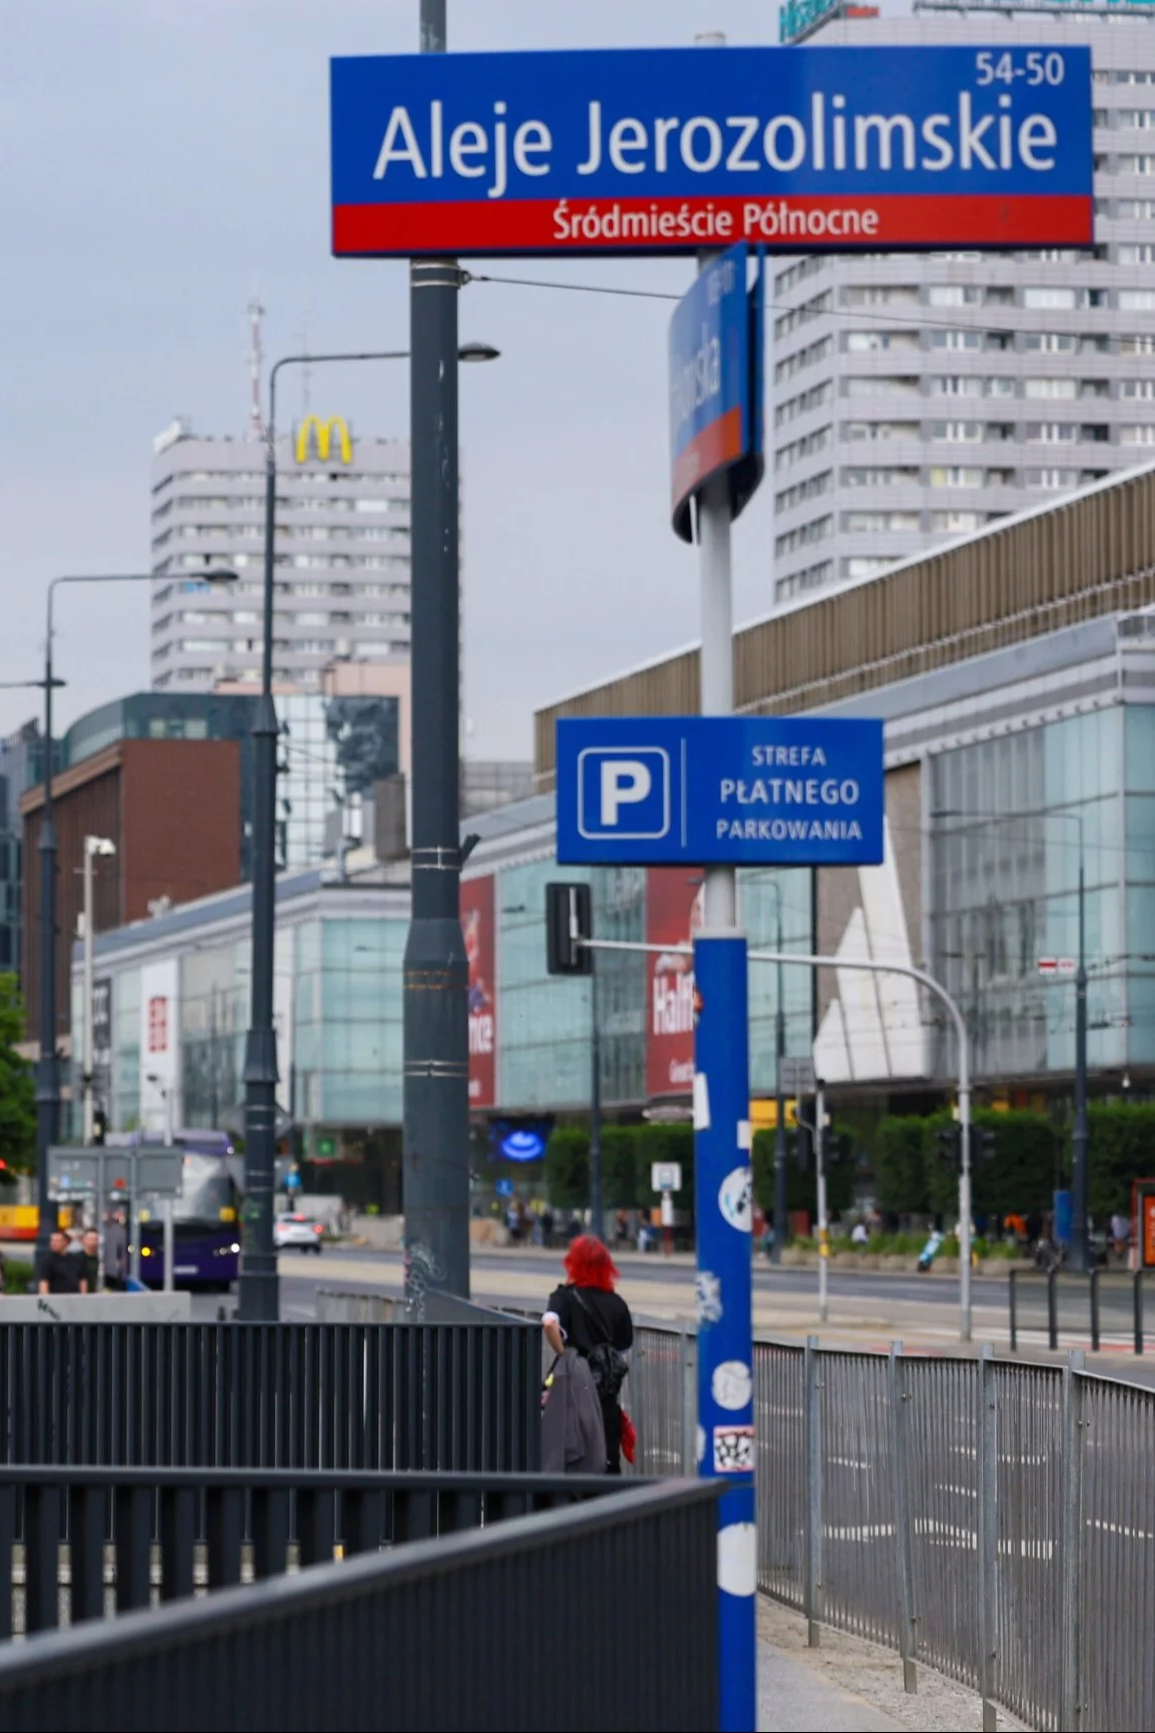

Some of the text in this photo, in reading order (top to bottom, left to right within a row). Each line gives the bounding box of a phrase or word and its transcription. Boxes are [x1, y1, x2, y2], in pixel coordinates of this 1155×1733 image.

[976, 53, 1064, 86] 54-50
[373, 91, 1057, 198] Aleje Jerozolimskie
[553, 199, 879, 240] Śródmieście Północne
[751, 744, 827, 767] STREFA
[600, 761, 651, 825] P
[720, 779, 860, 806] PŁATNEGO
[716, 819, 863, 841] PARKOWANIA
